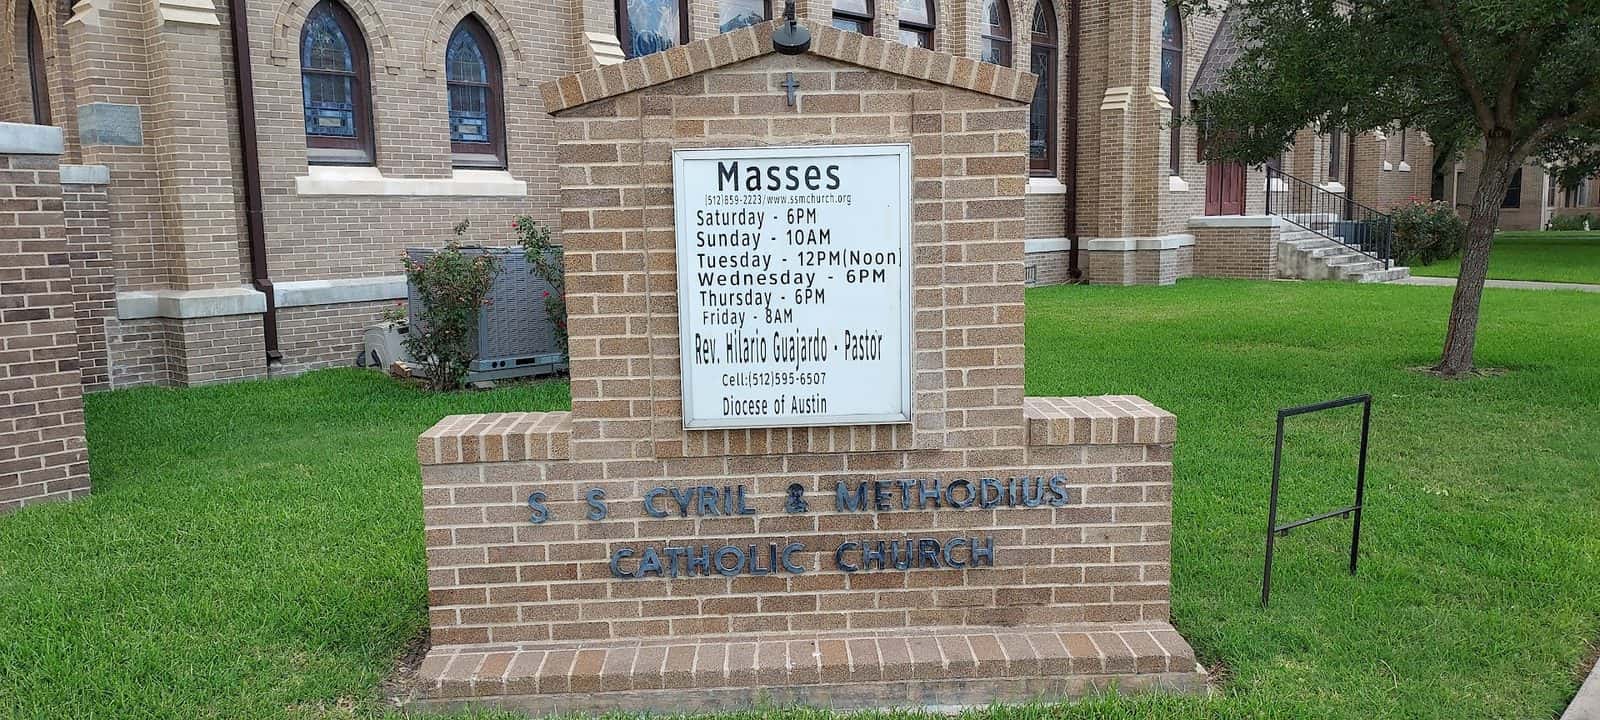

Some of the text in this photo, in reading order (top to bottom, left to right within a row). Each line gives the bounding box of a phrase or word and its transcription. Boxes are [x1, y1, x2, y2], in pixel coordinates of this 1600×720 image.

[716, 161, 842, 192] Masses
[696, 208, 765, 230] Saturday
[787, 208, 817, 225] 6PM
[696, 231, 761, 250] Sunday
[786, 229, 831, 246] 10AM
[697, 251, 772, 271] Tuesday
[797, 248, 902, 268] 12PM(Noon)
[698, 269, 816, 288] Wednesday
[846, 269, 885, 284] 6PM
[699, 289, 772, 309] Thursday
[795, 288, 825, 305] 6PM
[703, 310, 746, 329] Friday
[765, 309, 793, 324] 8AM
[695, 333, 720, 365] Rev.
[726, 328, 767, 364] Hilario
[773, 328, 828, 371] Guajardo
[844, 329, 884, 361] Pastor
[722, 372, 827, 387] Cell:(512)595-6507
[723, 393, 827, 416] Diocese of Austin
[528, 472, 1069, 524] S S CYRIL & METHODIUS
[610, 536, 995, 579] CATHOLIC CHURCH
